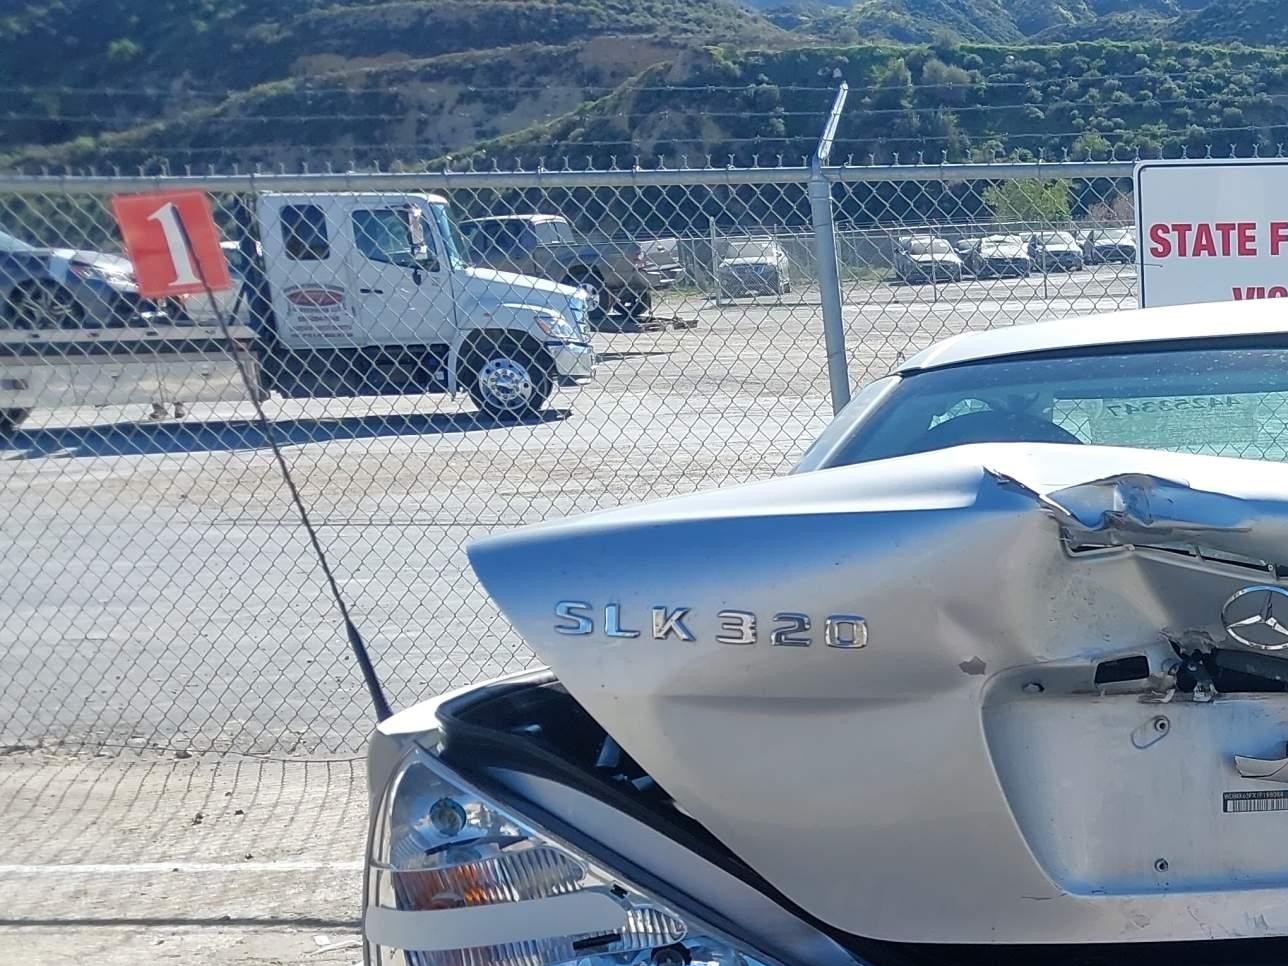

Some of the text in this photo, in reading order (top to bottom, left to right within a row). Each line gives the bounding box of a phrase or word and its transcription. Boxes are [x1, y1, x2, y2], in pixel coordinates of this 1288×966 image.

[147, 202, 201, 286] 1
[1150, 222, 1257, 258] STATE
[554, 600, 868, 650] SLK 320
